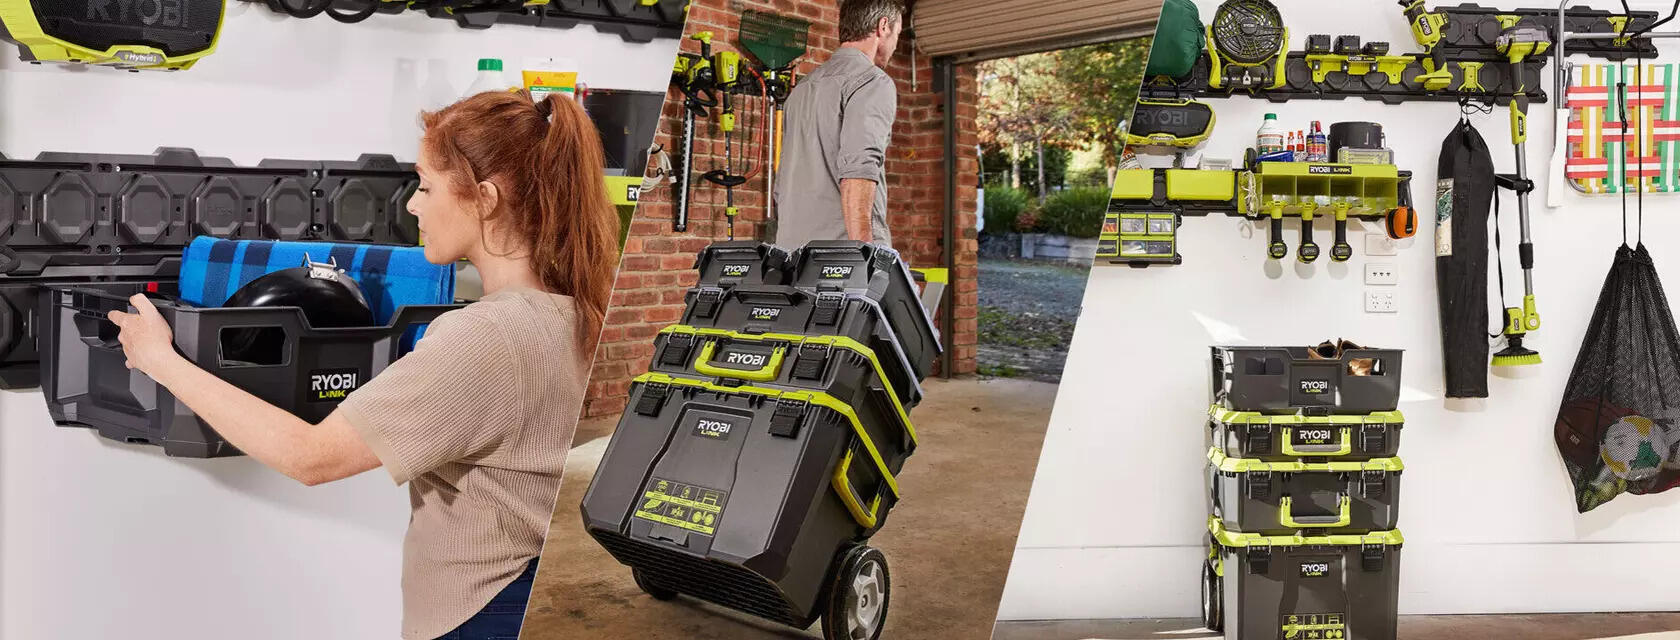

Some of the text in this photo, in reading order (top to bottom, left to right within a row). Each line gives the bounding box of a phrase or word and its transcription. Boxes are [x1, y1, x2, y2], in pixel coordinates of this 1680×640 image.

[129, 53, 153, 63] Hybrid
[1137, 110, 1188, 125] RYOBI
[723, 264, 750, 273] RYOBI
[822, 266, 852, 275] RYOBI
[752, 307, 780, 316] RYOBI
[727, 352, 766, 366] RYOBI
[311, 373, 357, 391] RYOBI
[1301, 381, 1328, 389] RYOBI
[319, 390, 346, 399] LINK
[698, 420, 731, 433] RYOBI
[1299, 430, 1331, 440] RYOBI
[1301, 564, 1328, 572] RYOBI
